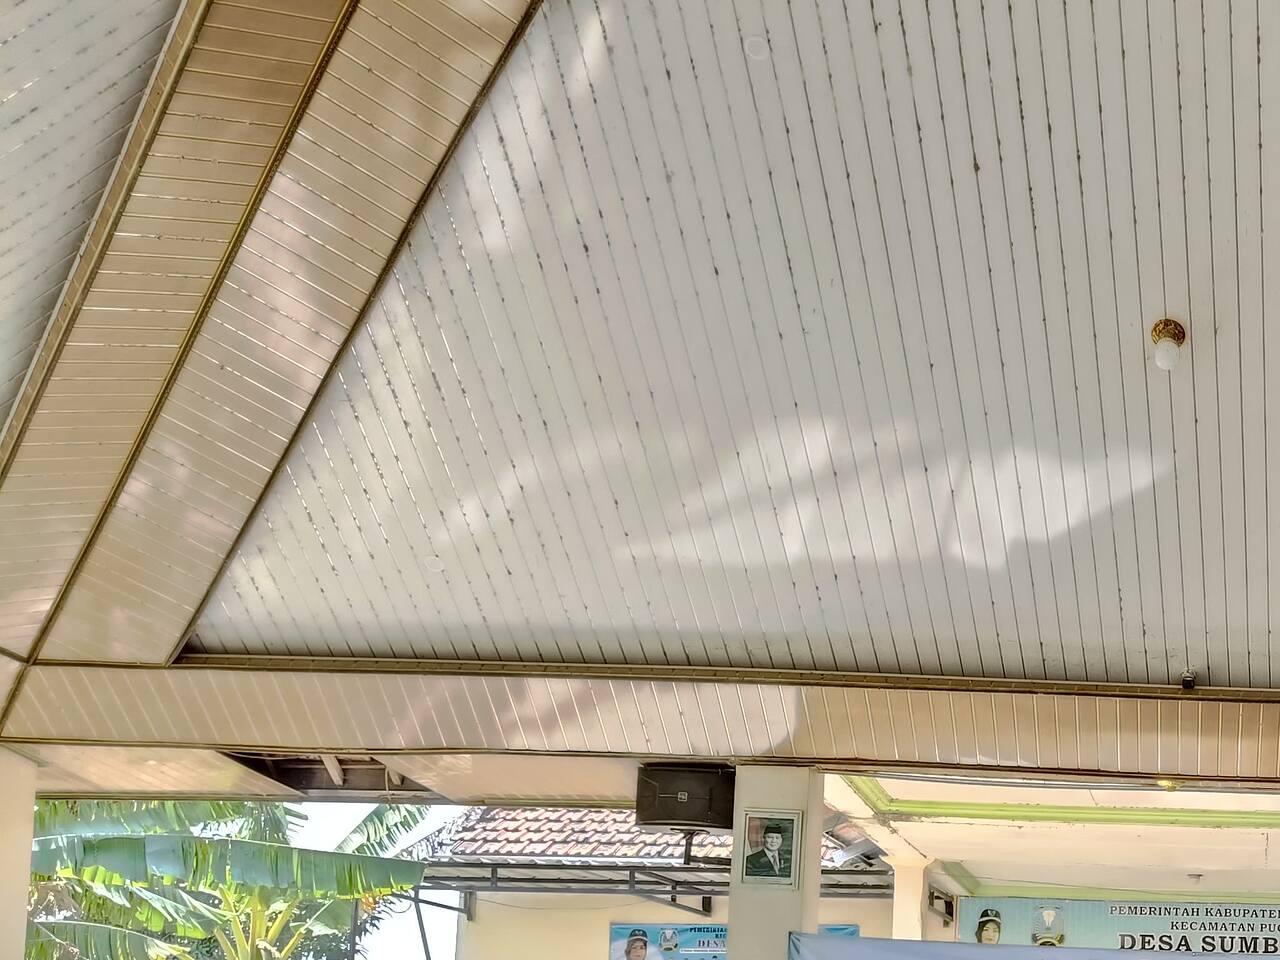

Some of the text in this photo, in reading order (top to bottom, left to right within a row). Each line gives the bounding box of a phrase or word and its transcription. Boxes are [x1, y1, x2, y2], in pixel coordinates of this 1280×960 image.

[1109, 905, 1201, 918] PEMERINTAH
[1170, 921, 1255, 932] KECAMATAN
[1118, 933, 1193, 952] DESA
